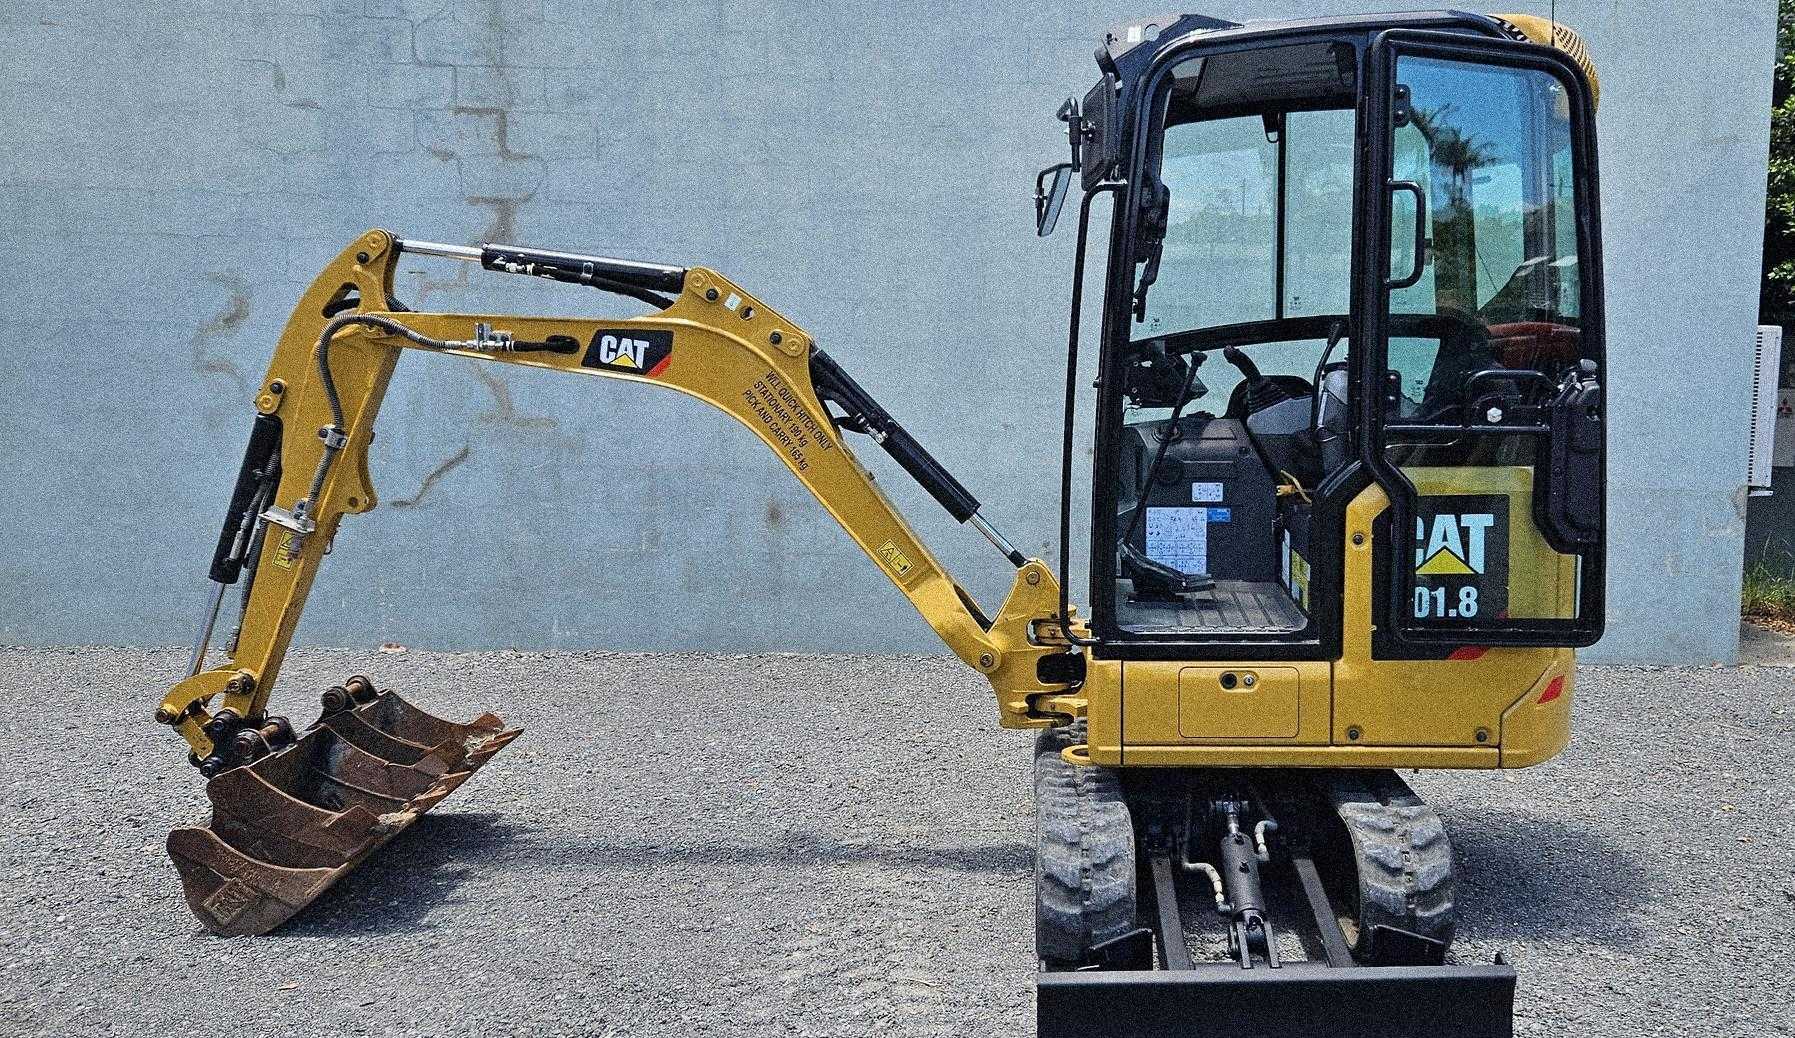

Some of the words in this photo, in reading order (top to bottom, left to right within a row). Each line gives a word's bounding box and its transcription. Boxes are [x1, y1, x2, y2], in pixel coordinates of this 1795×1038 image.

[600, 335, 649, 369] CAT
[742, 389, 760, 409] PICK
[756, 406, 773, 423] AND
[769, 422, 793, 447] CARRY
[788, 446, 803, 460] 165
[797, 457, 808, 471] kg
[753, 380, 793, 425] STATIONARY
[797, 433, 808, 448] kg
[765, 370, 783, 388] WLL
[778, 387, 801, 412] QUICK
[795, 409, 817, 433] HITCH
[813, 431, 833, 451] ONLY
[1416, 513, 1493, 574] AT
[1414, 586, 1478, 618] 01.8
